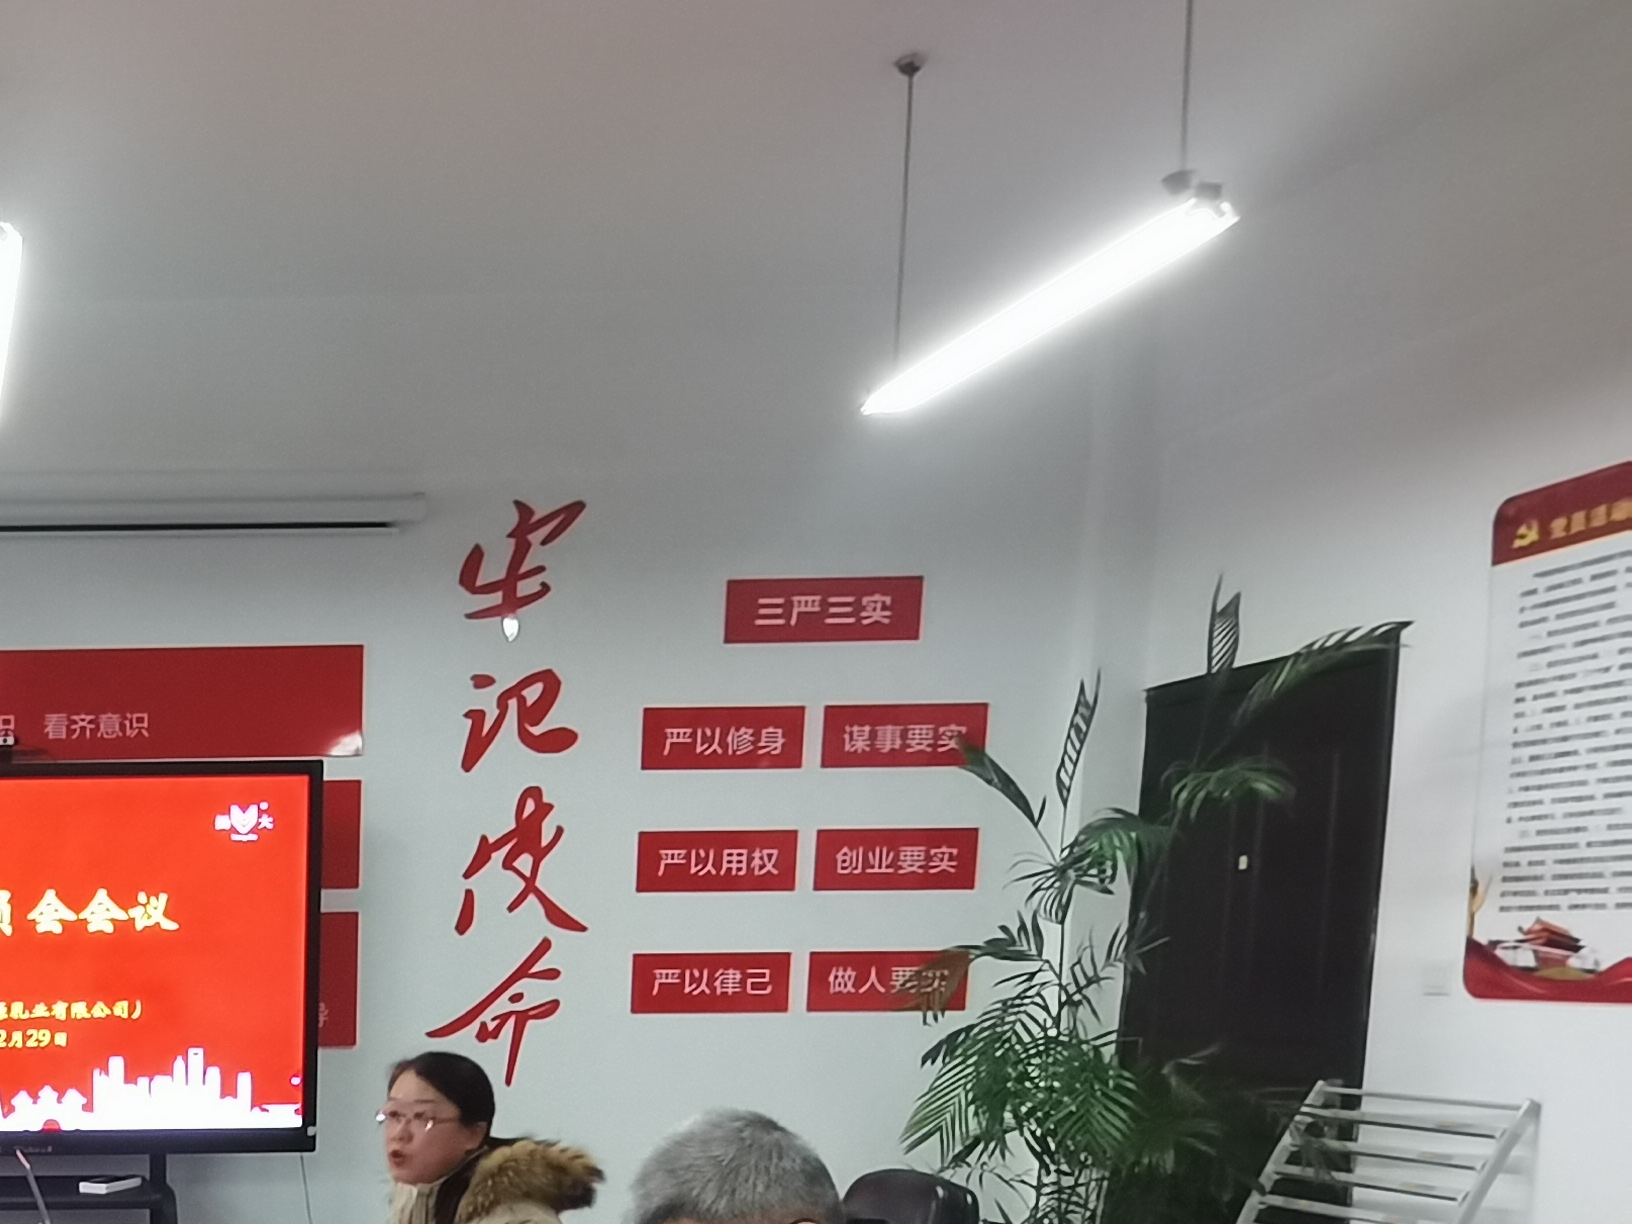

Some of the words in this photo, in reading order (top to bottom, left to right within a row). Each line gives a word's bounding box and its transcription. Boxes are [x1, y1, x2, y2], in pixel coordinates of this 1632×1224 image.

[754, 593, 892, 627] 三严三实
[43, 712, 149, 740] 看齐意识
[663, 726, 786, 756] 严以修身
[843, 723, 967, 754] 谋事要实
[658, 847, 779, 877] 严以用权
[835, 845, 958, 874] 创业要实
[652, 968, 773, 996] 严以律己
